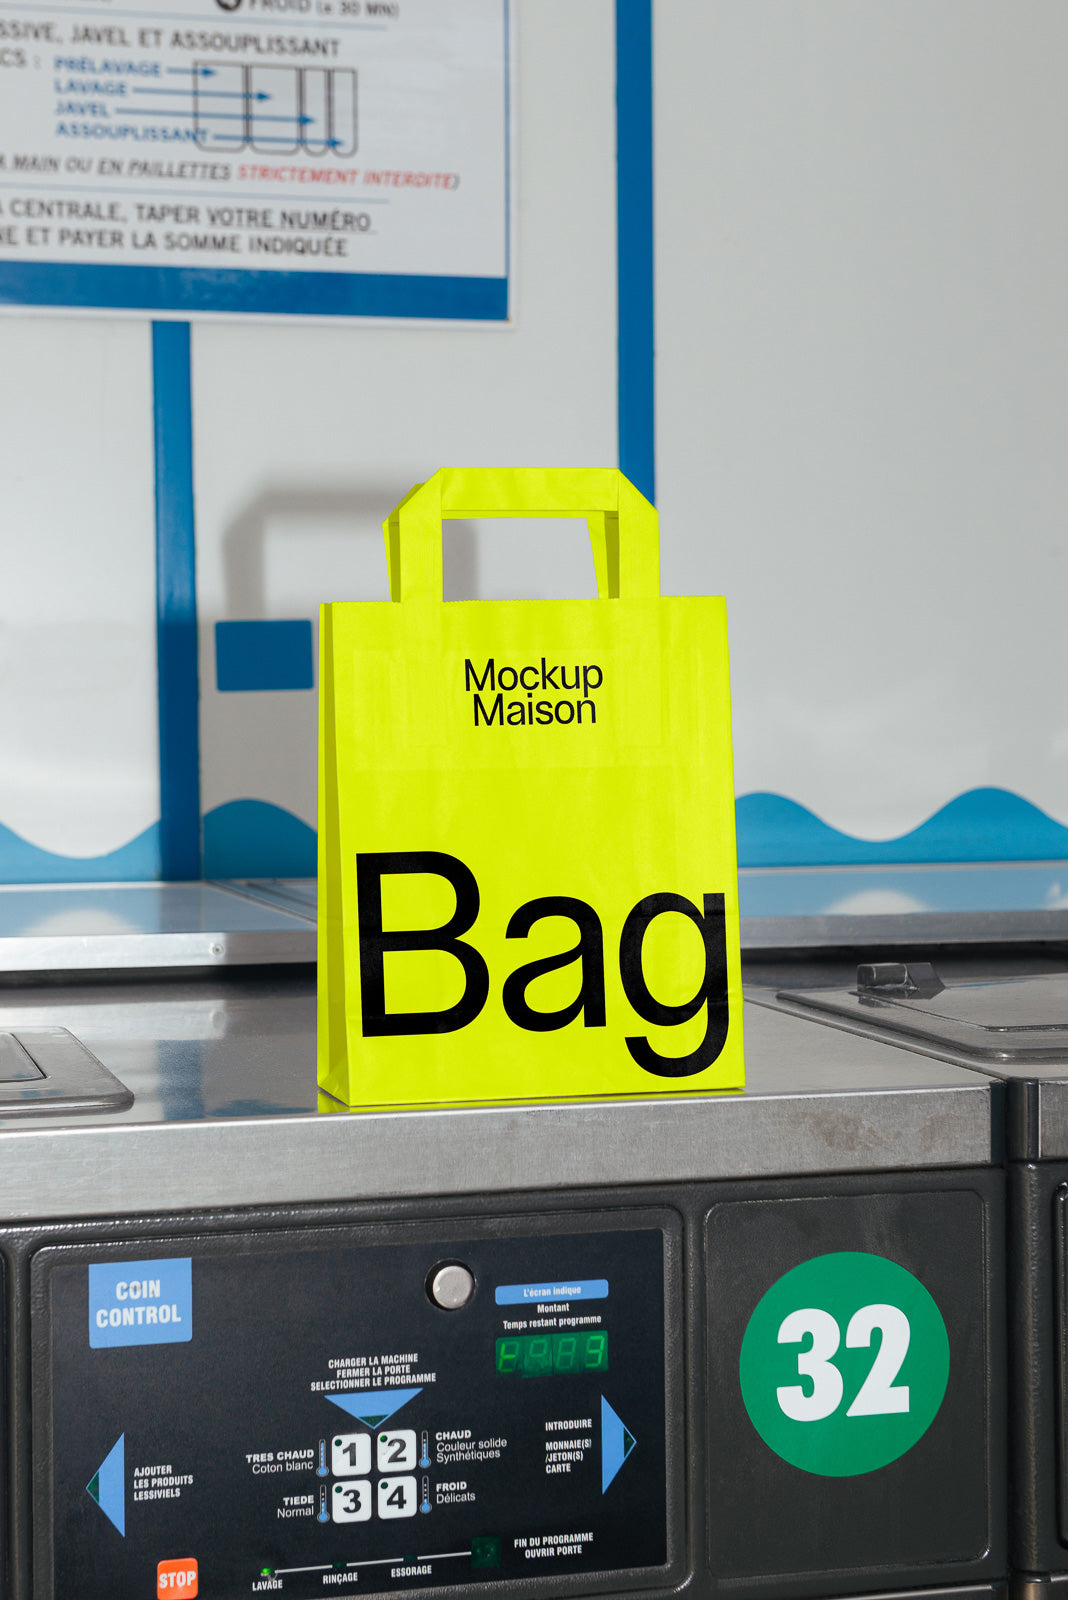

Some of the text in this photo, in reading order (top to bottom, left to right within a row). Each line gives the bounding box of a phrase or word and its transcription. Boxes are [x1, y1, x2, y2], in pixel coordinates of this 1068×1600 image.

[70, 23, 130, 48] JAVEL
[137, 28, 164, 48] ET
[169, 28, 341, 57] ASSOUPLISSANT
[53, 77, 128, 97] LAVAGE
[56, 101, 110, 119] JAVEL
[55, 122, 209, 143] ASSOUPLISSANT
[14, 154, 59, 173] MAIN
[65, 156, 93, 174] OU
[96, 158, 123, 176] EN
[127, 158, 231, 181] PAILLETTES
[237, 163, 360, 186] STRICTEMENT
[9, 198, 128, 223] CENTRALE,
[136, 204, 201, 225] TAPER
[207, 208, 275, 230] VOTRE
[280, 207, 373, 234] NUMÉRO
[26, 228, 51, 246] ET
[58, 229, 125, 249] PAYER
[132, 232, 157, 251] LA
[164, 232, 242, 255] SOMME
[249, 234, 349, 259] INDIQUÉE
[465, 657, 604, 698] Mockup
[473, 692, 597, 727] Maison
[356, 850, 729, 1078] Bag
[116, 1279, 161, 1301] COIN
[523, 1285, 582, 1298] L'écran indique
[537, 1302, 570, 1313] Montant
[96, 1304, 182, 1329] CONTROL
[503, 1315, 602, 1331] Temps restant programme
[328, 1353, 419, 1369] CHARGER LA MACHINE
[776, 1303, 911, 1422] 32
[336, 1364, 411, 1379] FERMER LA PORTE
[310, 1373, 437, 1391] SELECTIONNER LE PROGRAMME
[545, 1418, 592, 1431] INTRODUIRE
[435, 1429, 472, 1441] CHAUD
[387, 1438, 407, 1464] 2
[436, 1437, 507, 1452] Couleur solide
[246, 1449, 314, 1463] TRES CHAUD
[342, 1442, 357, 1467] 1
[436, 1449, 501, 1465] Synthétiques
[545, 1451, 584, 1463] /JETON(S)
[134, 1464, 172, 1477] AJOUTER
[252, 1460, 313, 1475] Coton blanc
[545, 1463, 571, 1474] CARTE
[134, 1475, 194, 1489] LES PRODUITS
[436, 1481, 467, 1492] FROID
[134, 1487, 181, 1501] LESSIVIELS
[283, 1494, 314, 1506] TIEDE
[342, 1489, 362, 1514] 3
[386, 1485, 407, 1509] 4
[436, 1492, 476, 1504] Délicats
[277, 1506, 314, 1519] Normal
[514, 1532, 594, 1548] FIN DU PROGRAMME
[525, 1544, 582, 1559] OUVRIR PORTE
[159, 1570, 196, 1589] STOP
[322, 1572, 358, 1586] RINÇAGE
[391, 1565, 432, 1578] ESSORAGE
[252, 1579, 283, 1592] LAVAGE
